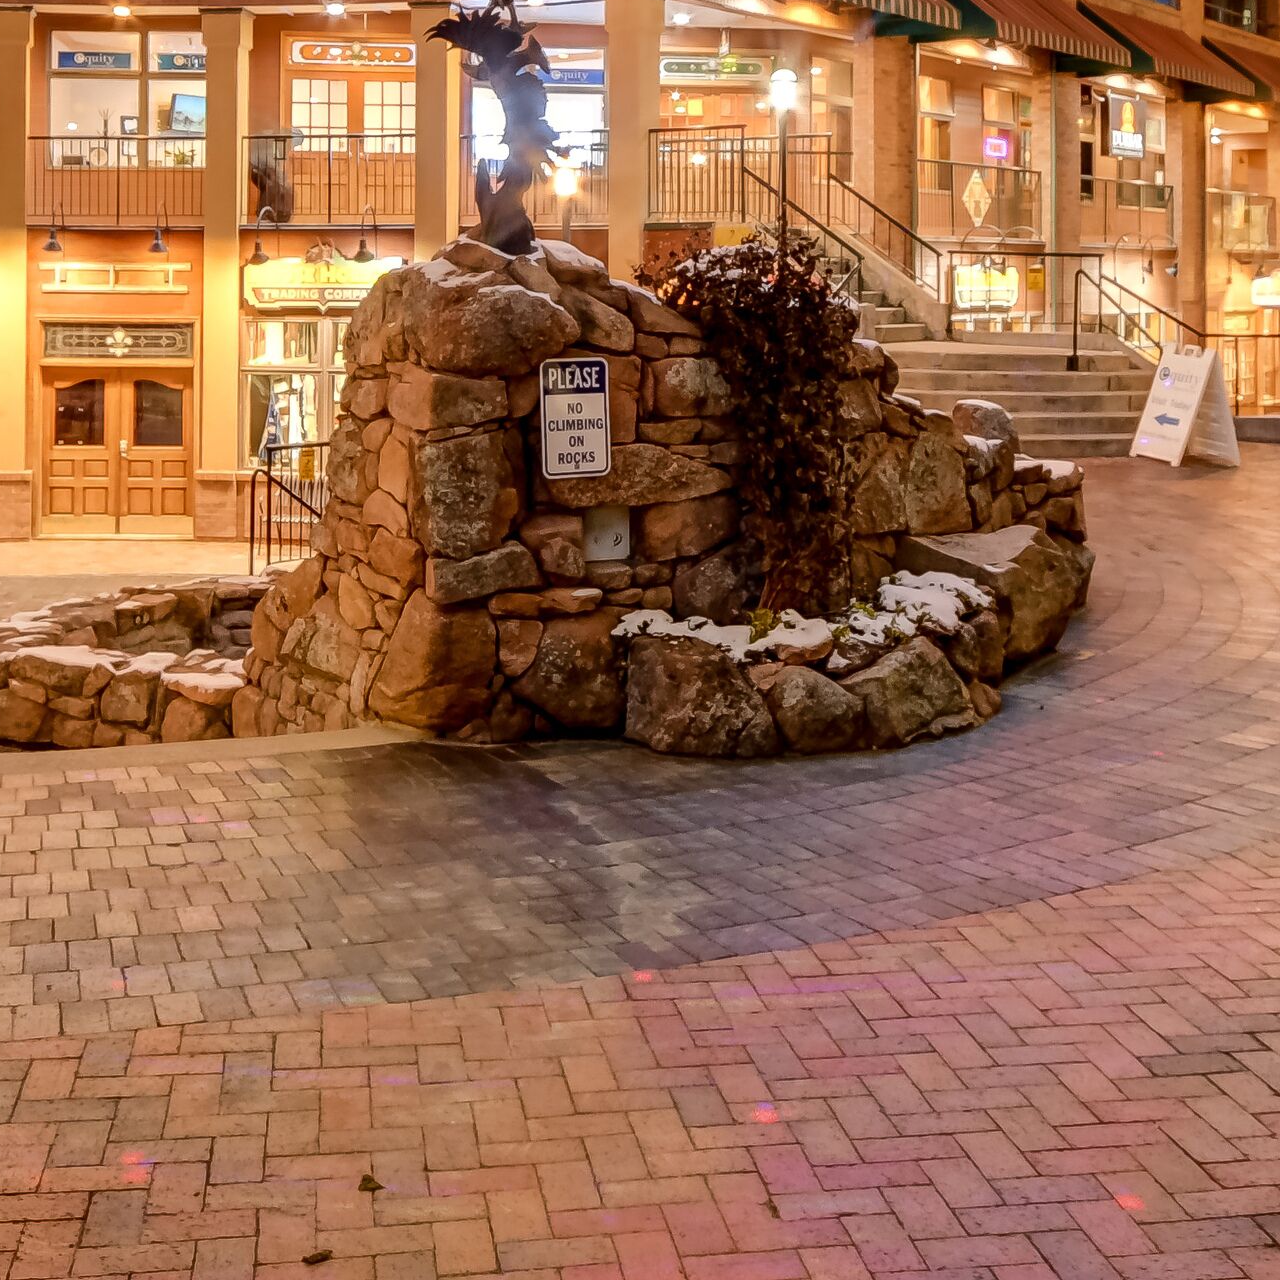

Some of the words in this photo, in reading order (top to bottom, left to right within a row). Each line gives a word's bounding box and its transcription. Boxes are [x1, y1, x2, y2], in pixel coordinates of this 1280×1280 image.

[261, 289, 319, 300] TRADING
[324, 289, 371, 300] COMPA
[548, 366, 601, 389] PLEASE
[567, 402, 584, 415] NO
[548, 418, 604, 432] CLIMBING
[568, 435, 585, 448] ON
[558, 451, 596, 465] ROCKS
